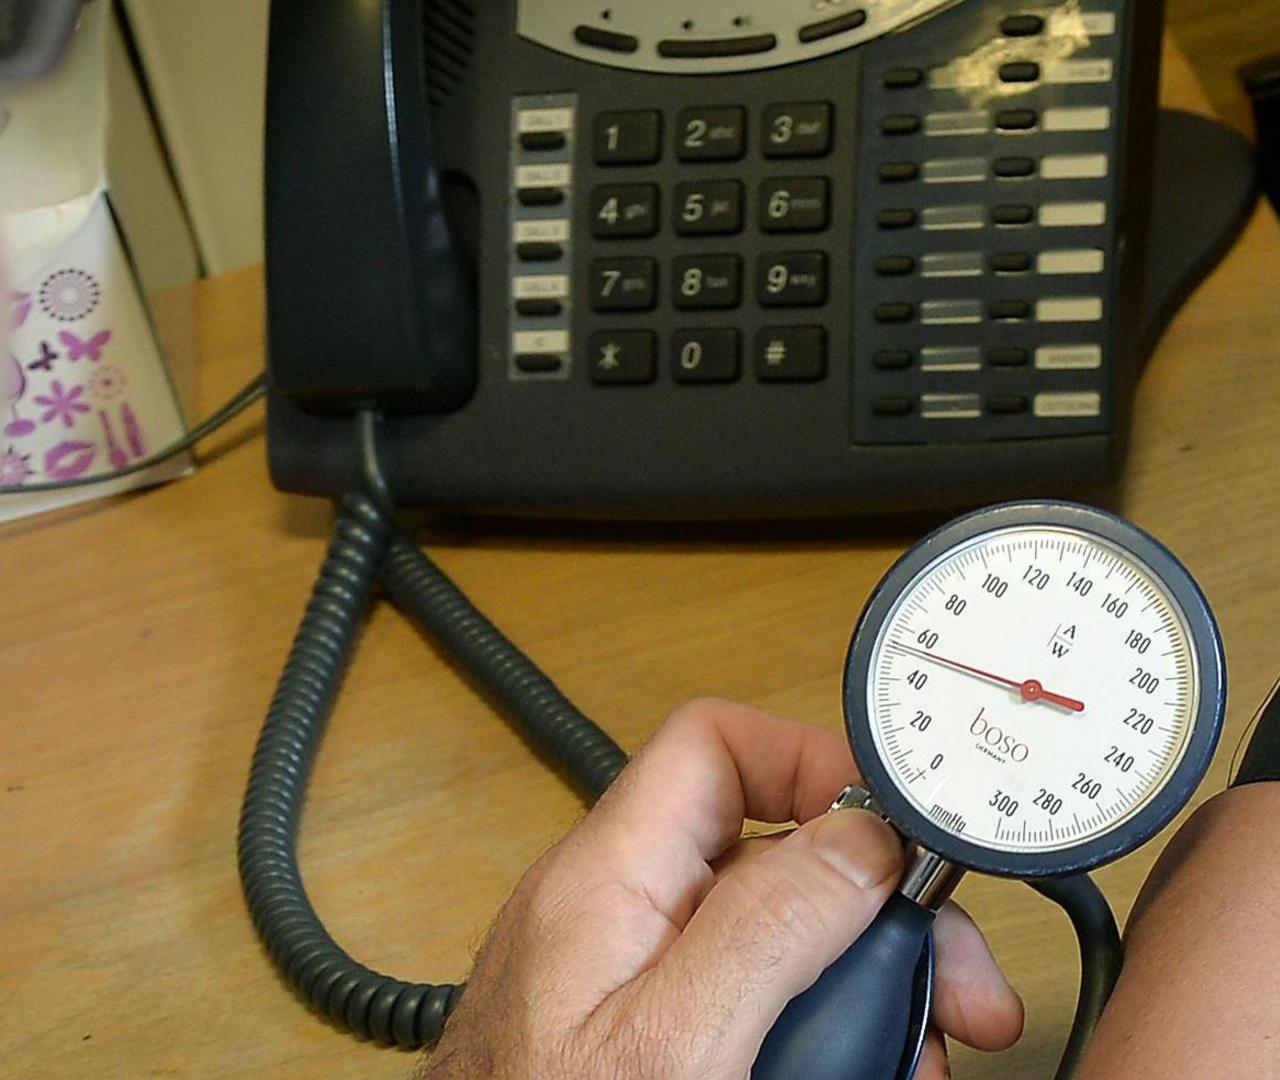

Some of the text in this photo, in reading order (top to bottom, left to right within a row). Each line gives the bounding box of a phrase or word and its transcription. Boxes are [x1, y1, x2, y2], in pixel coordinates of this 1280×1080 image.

[606, 125, 619, 150] 1
[684, 119, 706, 147] 2
[771, 115, 793, 144] 3
[599, 197, 618, 224] 4
[682, 193, 703, 222] 5
[768, 190, 790, 218] 6
[601, 270, 621, 296] 7
[681, 268, 702, 296] 8
[766, 264, 788, 293] 9
[681, 341, 702, 369] 0
[981, 573, 1009, 599] 100
[1022, 564, 1050, 591] 120
[1066, 571, 1094, 597] 140
[945, 593, 967, 616] 80
[1100, 593, 1129, 619] 160
[916, 628, 939, 650] 60
[1124, 629, 1152, 655] 180
[906, 669, 928, 691] 40
[1128, 667, 1160, 695] 200
[909, 710, 932, 732] 20
[969, 706, 1029, 764] boso
[1122, 707, 1154, 735] 220
[929, 753, 944, 770] 0
[1103, 745, 1135, 773] 240
[1071, 772, 1102, 800] 260
[988, 789, 1019, 817] 300
[1032, 788, 1063, 816] 280
